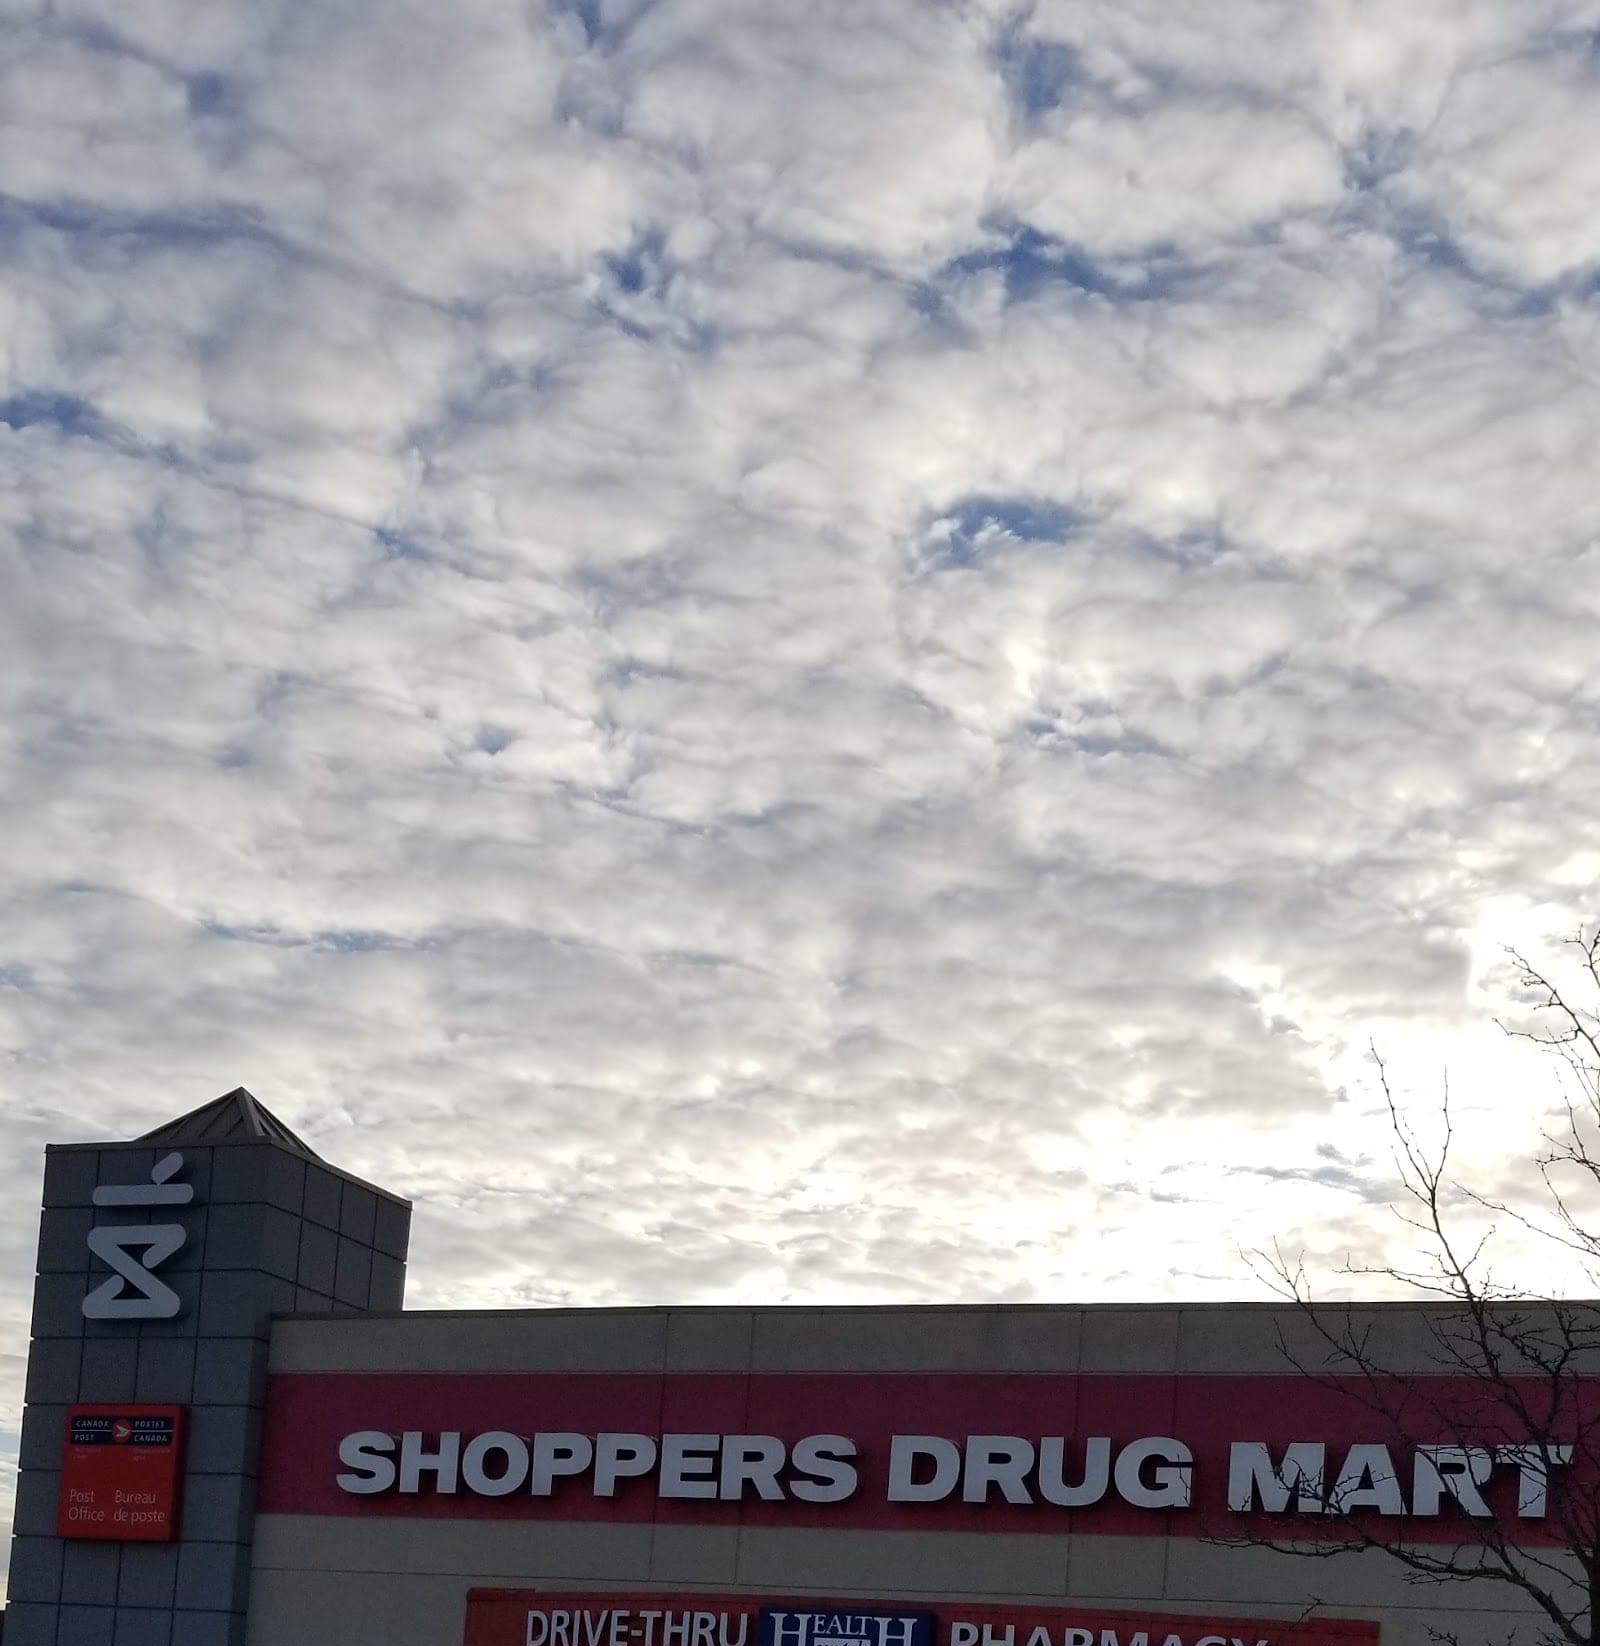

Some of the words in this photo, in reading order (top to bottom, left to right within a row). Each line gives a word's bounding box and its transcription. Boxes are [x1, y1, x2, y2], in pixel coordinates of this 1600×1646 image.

[76, 1420, 110, 1428] CANADA
[134, 1434, 168, 1442] CANADA
[336, 1430, 858, 1502] SHOPPERS
[887, 1434, 1194, 1508] DRUG
[1227, 1441, 1574, 1519] MART
[70, 1488, 95, 1504] Post
[115, 1489, 157, 1505] Bureau
[68, 1506, 105, 1522] Office
[113, 1508, 129, 1522] de
[131, 1510, 165, 1527] poste
